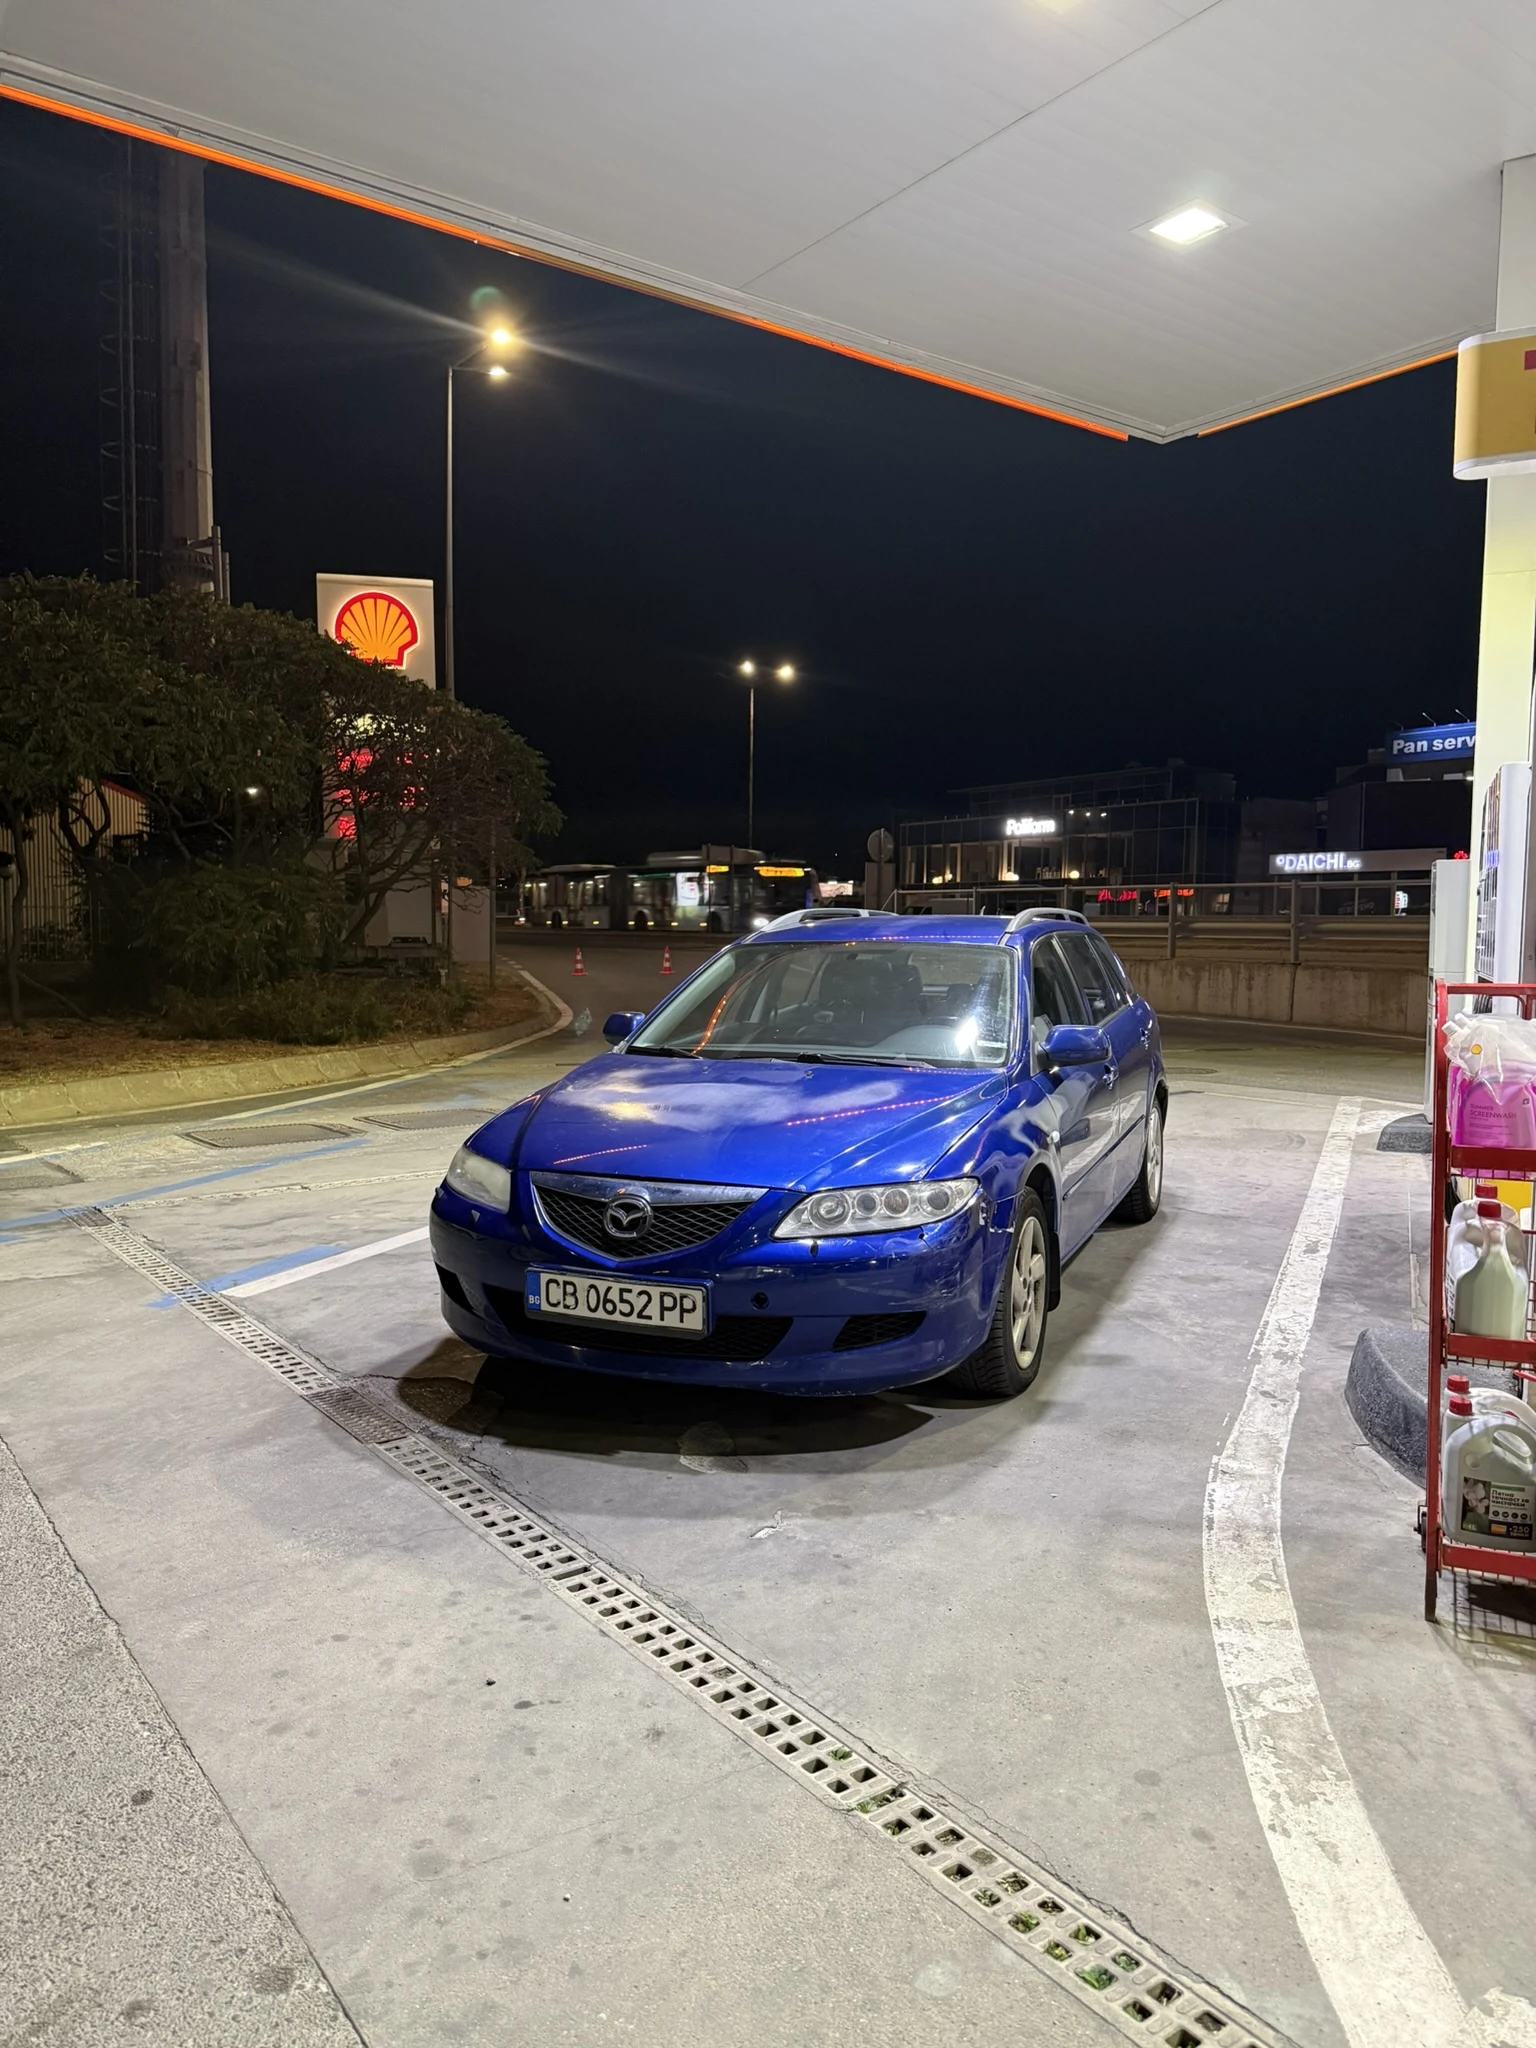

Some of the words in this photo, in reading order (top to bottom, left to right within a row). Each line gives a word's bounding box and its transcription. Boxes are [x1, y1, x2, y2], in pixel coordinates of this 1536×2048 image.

[1392, 739, 1428, 755] Pan
[1470, 1109, 1517, 1119] SCREENWASH
[529, 1294, 541, 1305] BG
[545, 1278, 579, 1310] CB
[586, 1283, 653, 1320] 0652
[659, 1291, 697, 1324] PP
